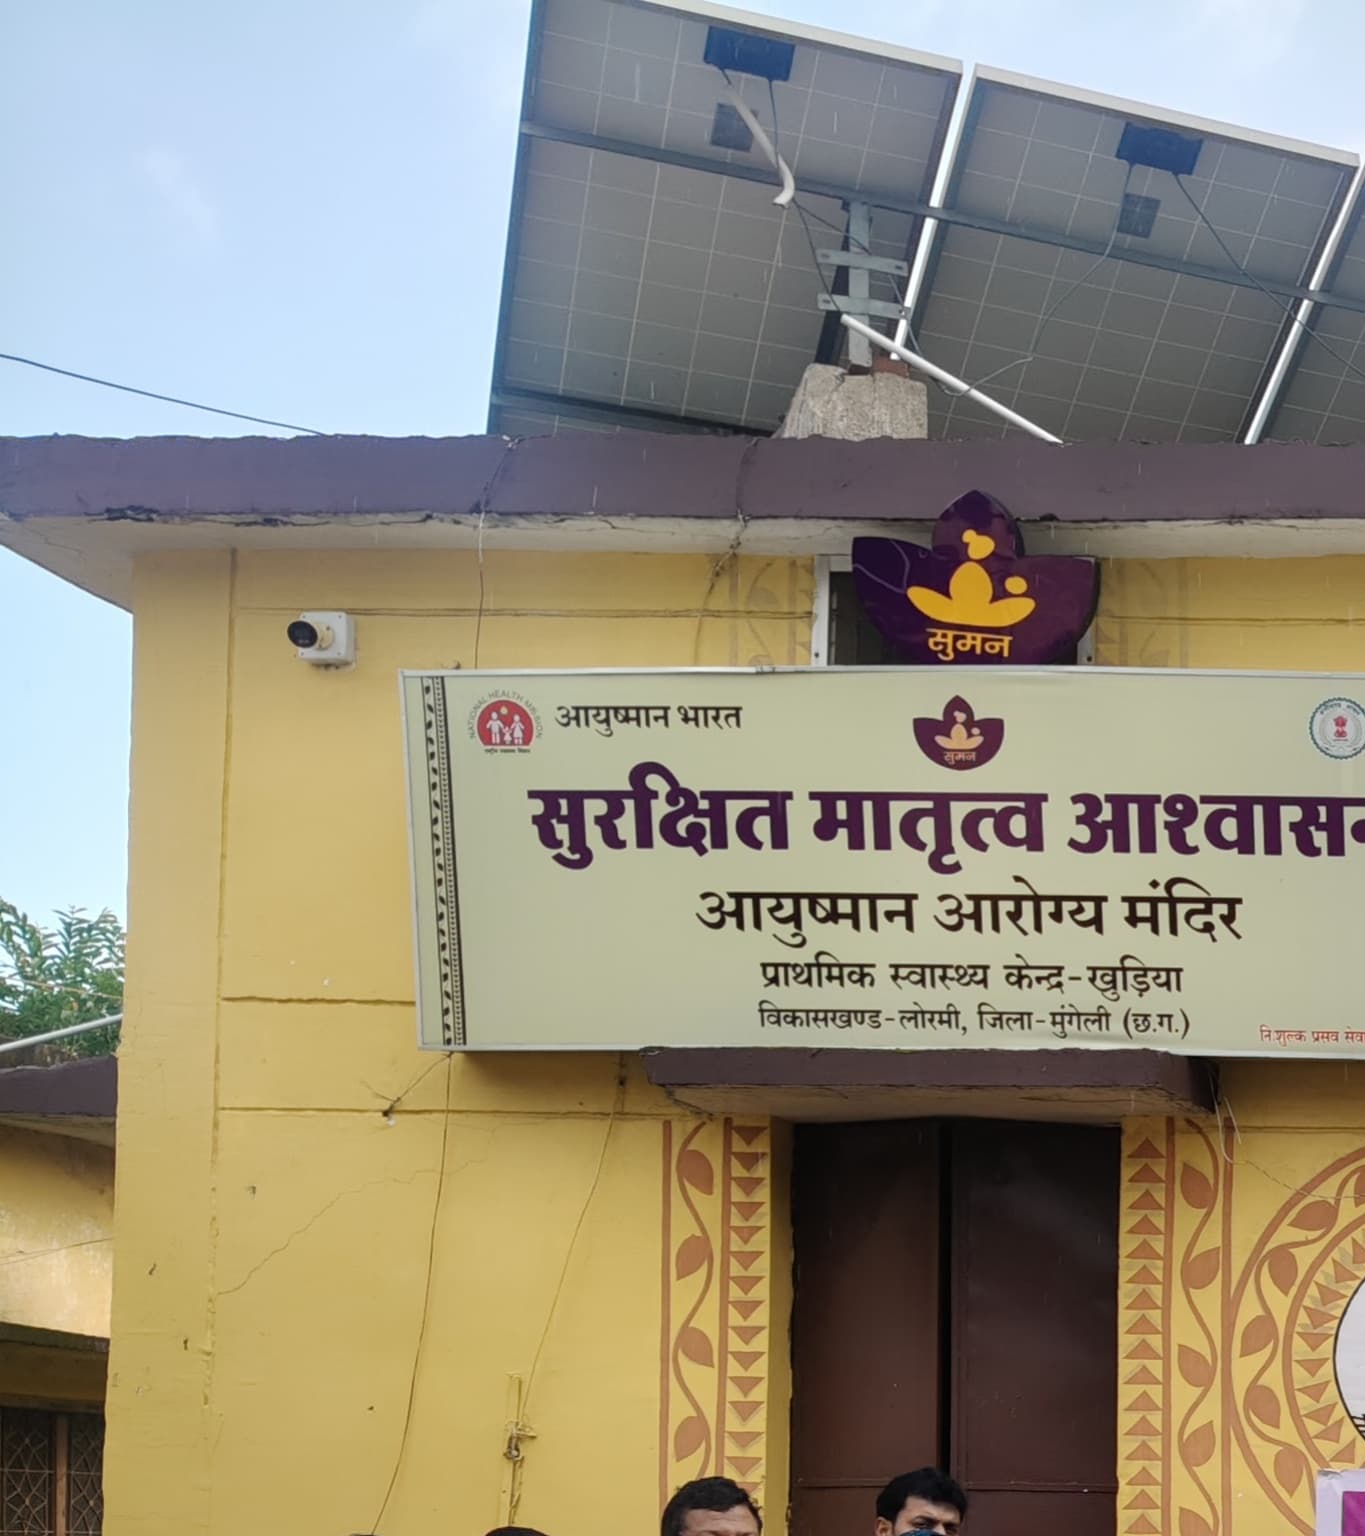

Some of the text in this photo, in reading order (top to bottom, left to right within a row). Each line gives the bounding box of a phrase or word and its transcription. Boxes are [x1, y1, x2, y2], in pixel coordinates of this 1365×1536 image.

[926, 628, 1013, 661] सुमन
[554, 705, 742, 738] आयुष्मान भारत
[943, 752, 976, 765] सुमन
[527, 761, 793, 870] सुरक्षित
[808, 791, 1048, 875] मातृत्व
[696, 876, 1243, 948] आयुष्मान आरोग्य मंदिर
[761, 951, 876, 989] प्राथमिक
[889, 963, 989, 990] स्वास्थ्य
[1123, 1010, 1190, 1039] (छ.ग.)
[1311, 1031, 1339, 1043] प्रसव
